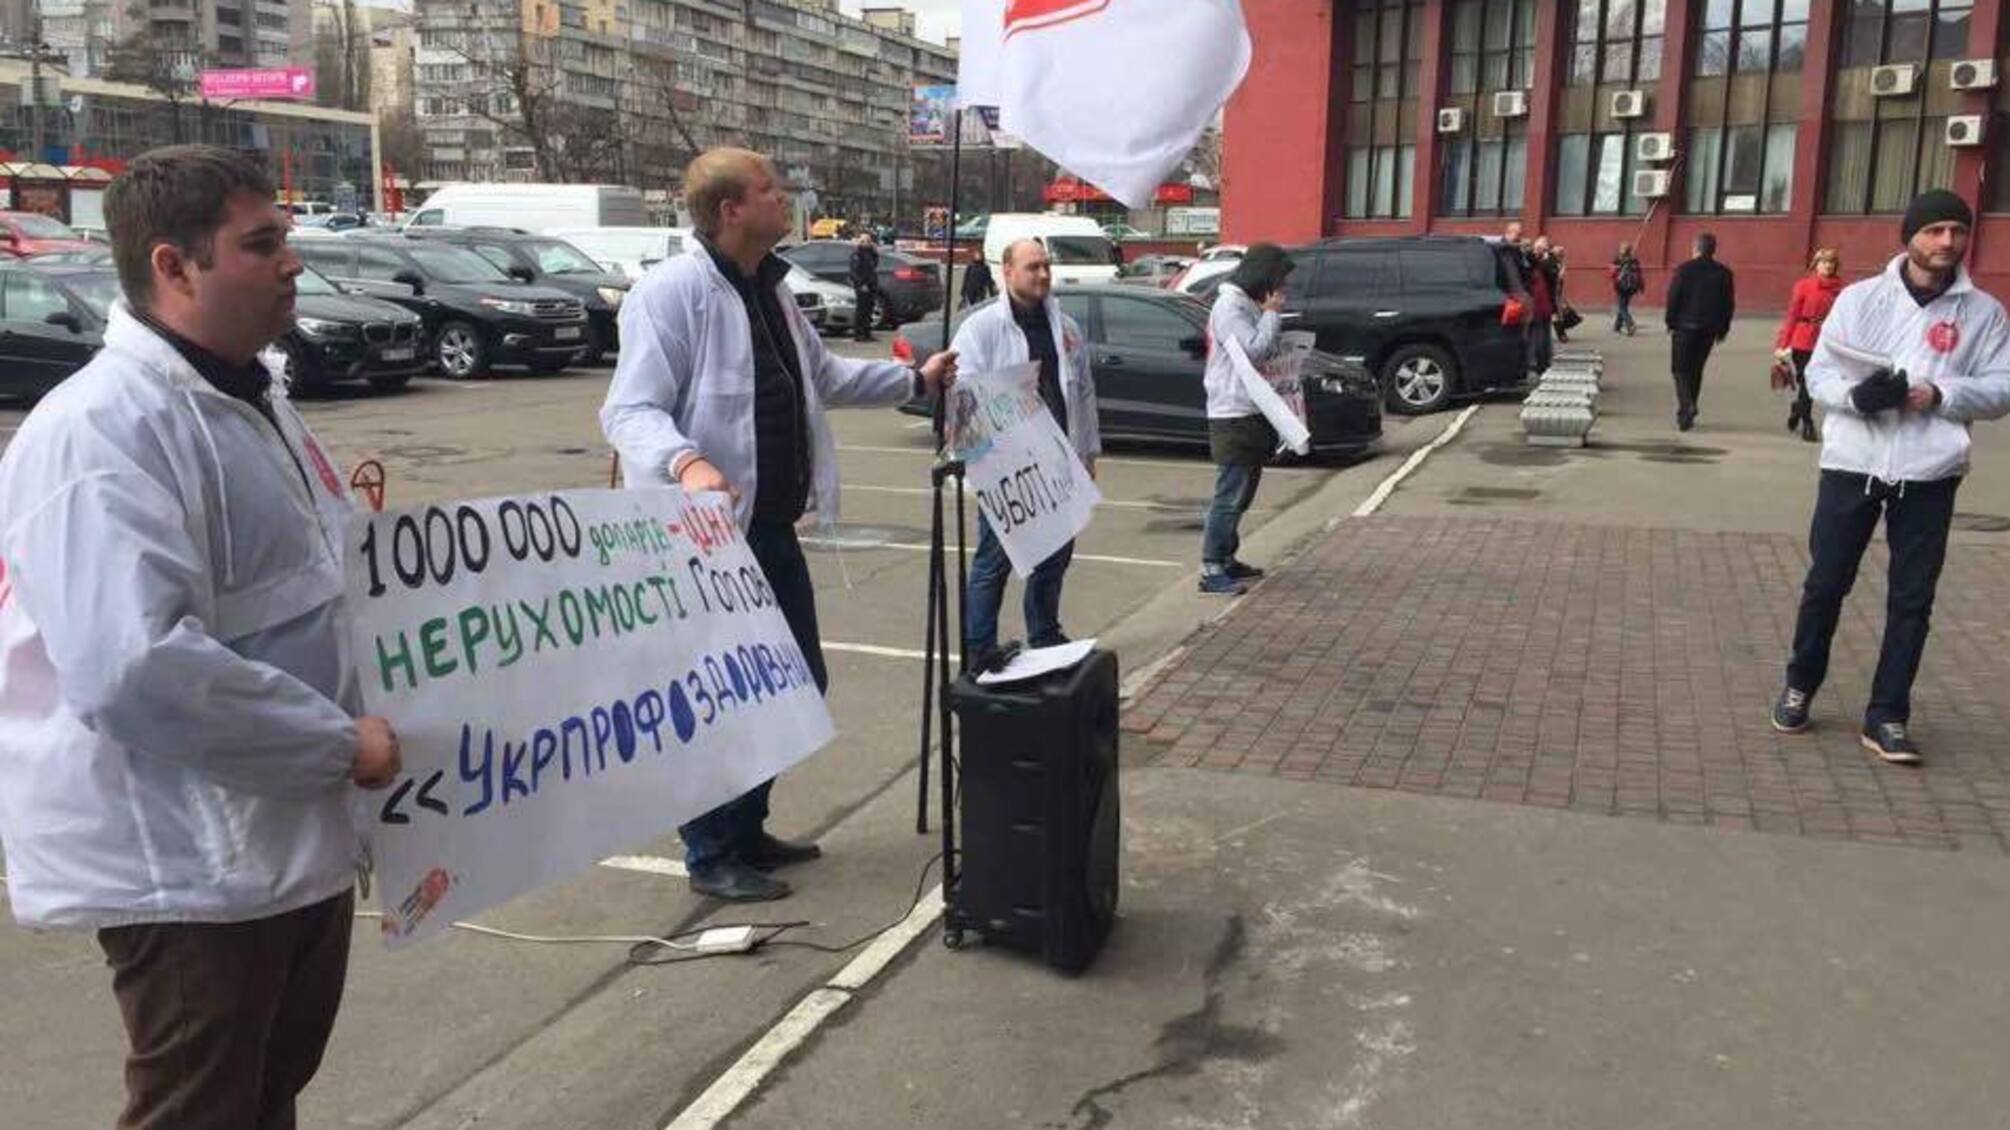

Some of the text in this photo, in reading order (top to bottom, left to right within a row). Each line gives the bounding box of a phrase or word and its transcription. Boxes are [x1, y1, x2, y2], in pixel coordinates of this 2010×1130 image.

[361, 507, 490, 597] 1000
[499, 496, 581, 562] 000
[375, 561, 687, 692] НЕРУХОМОСТІ
